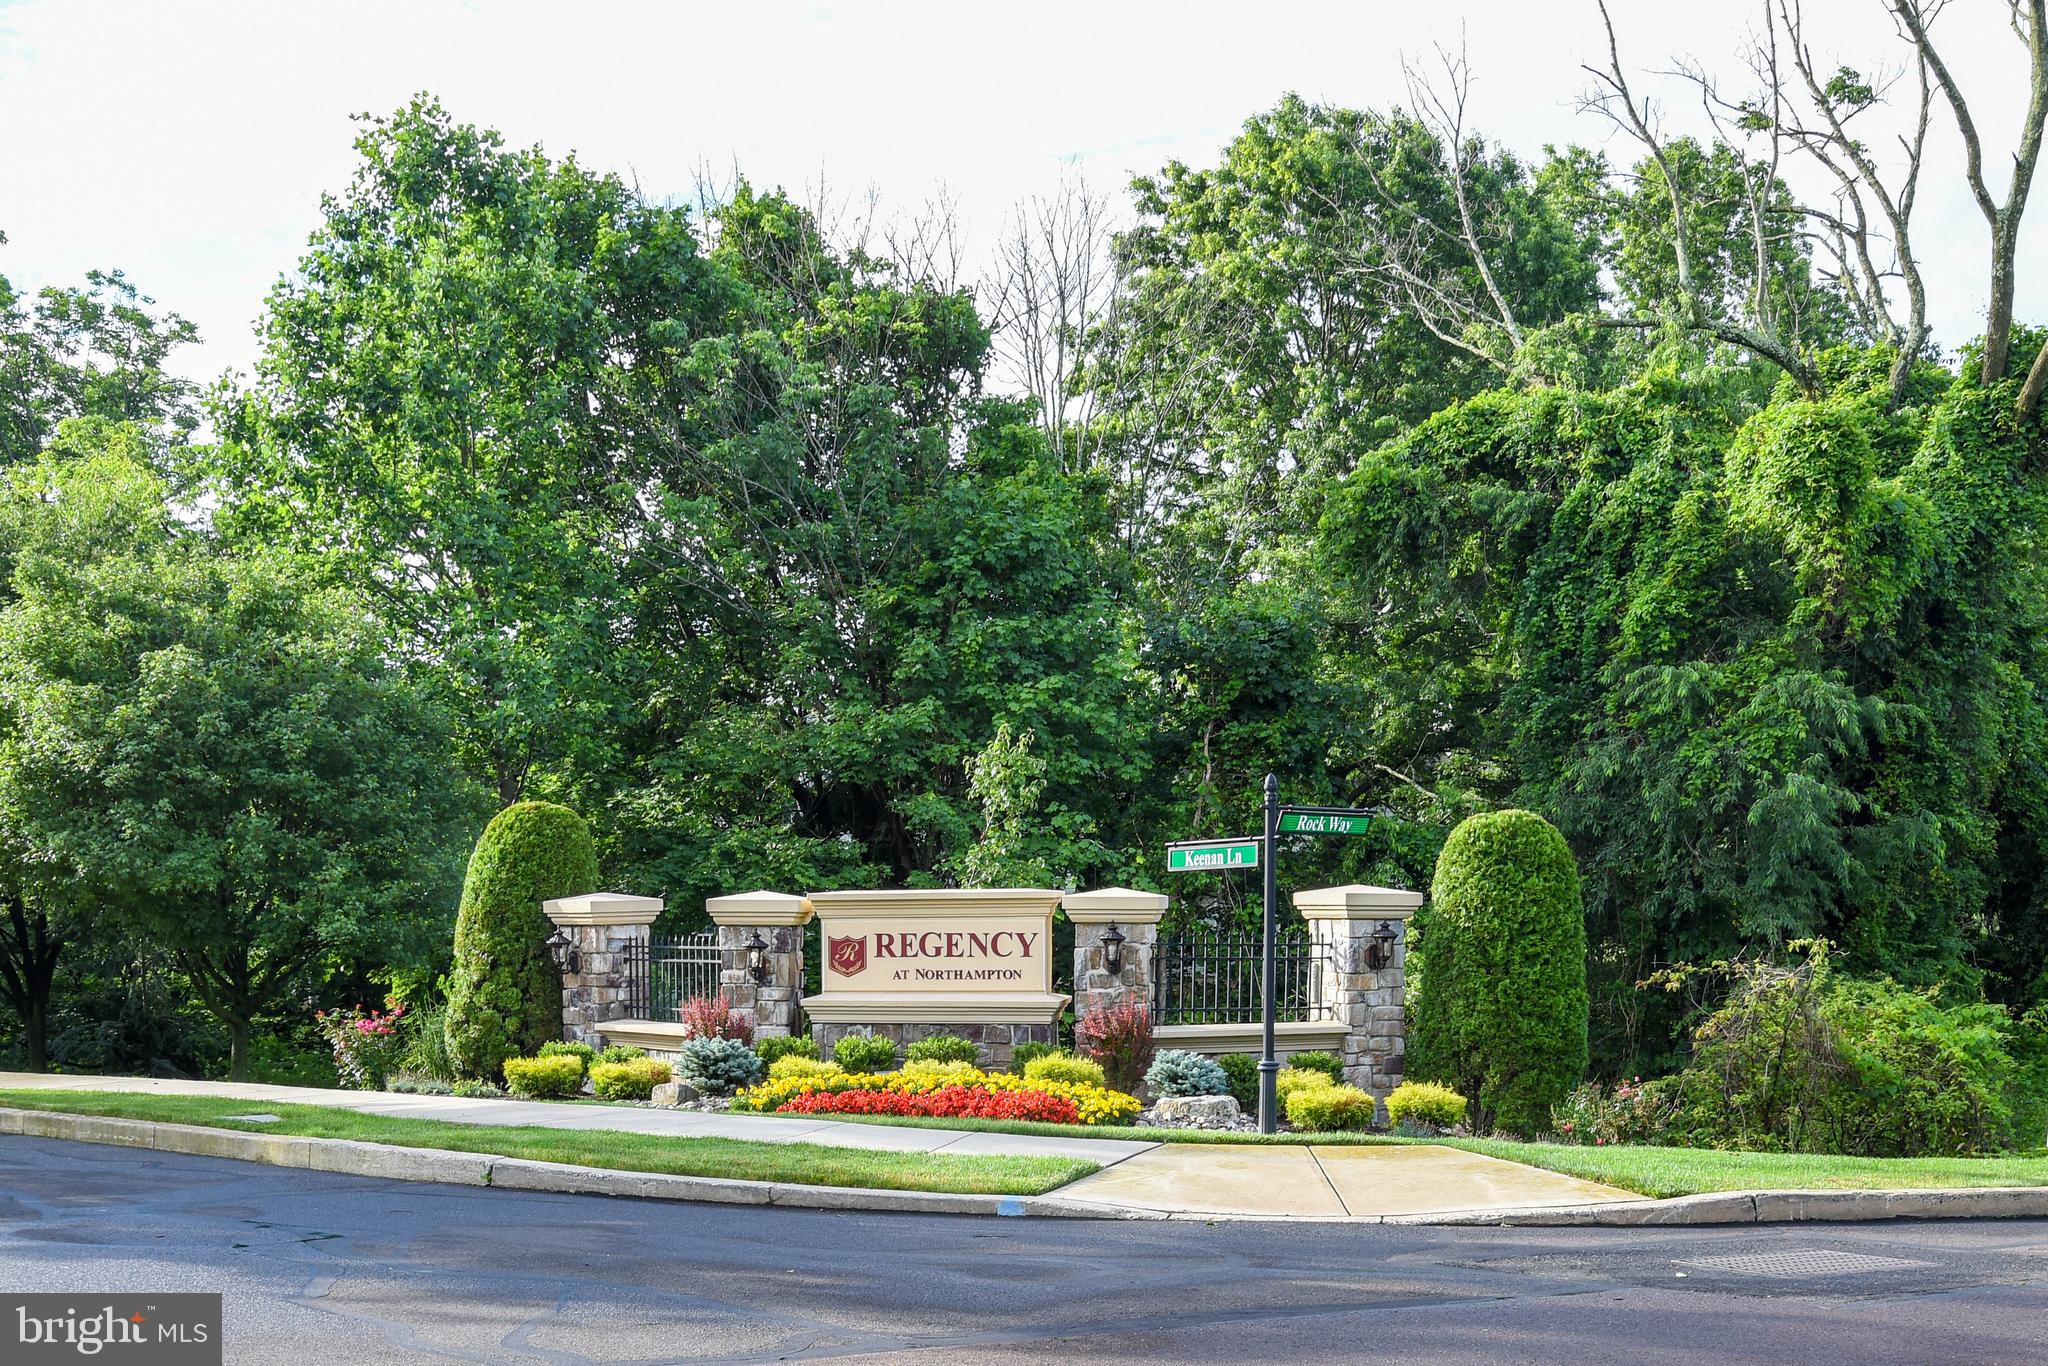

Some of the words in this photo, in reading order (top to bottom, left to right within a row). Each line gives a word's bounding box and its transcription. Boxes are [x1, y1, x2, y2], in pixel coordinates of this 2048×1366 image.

[1296, 815, 1326, 832] Rock
[1330, 816, 1353, 833] Way
[1184, 850, 1224, 867] Keenan
[1227, 848, 1242, 865] Ln
[874, 932, 1039, 958] REGENCY
